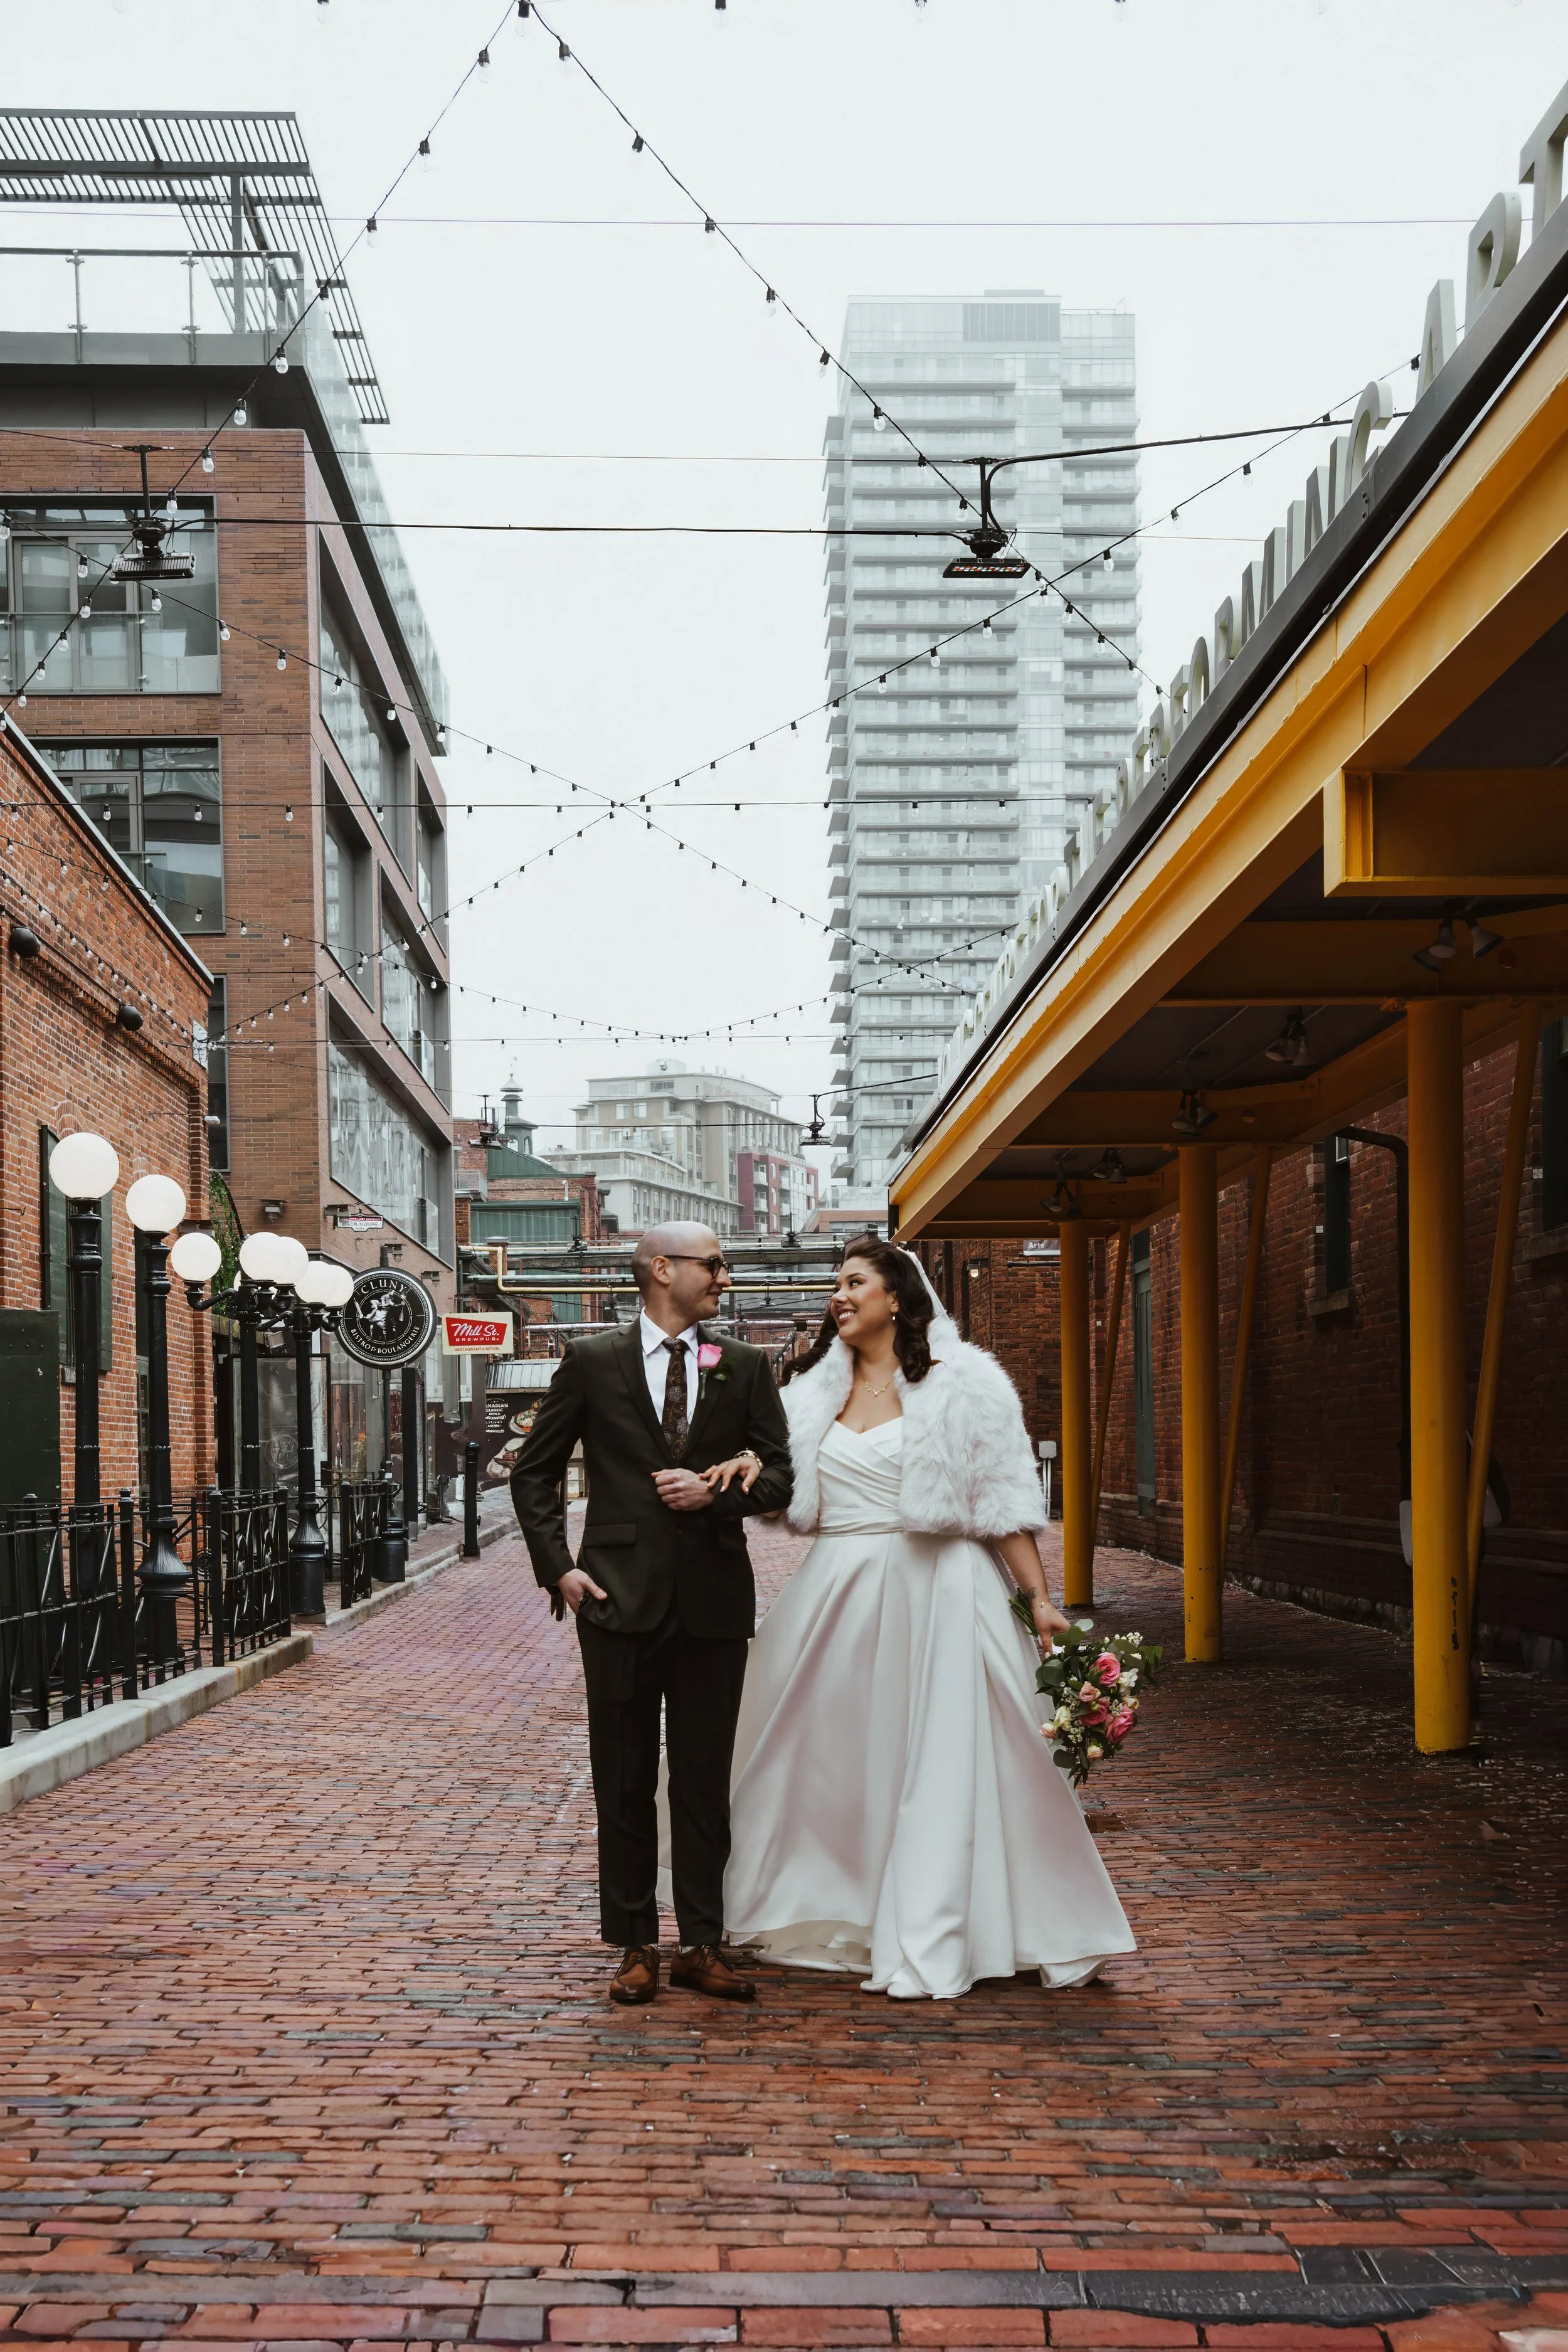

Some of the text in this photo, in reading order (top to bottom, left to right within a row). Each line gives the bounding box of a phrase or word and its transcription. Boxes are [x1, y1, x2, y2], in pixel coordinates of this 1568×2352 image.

[361, 1279, 406, 1294] CLUNY
[451, 1323, 500, 1337] Mill St.
[350, 1328, 371, 1350] BISTRO
[378, 1325, 420, 1354] BOULANGERIE
